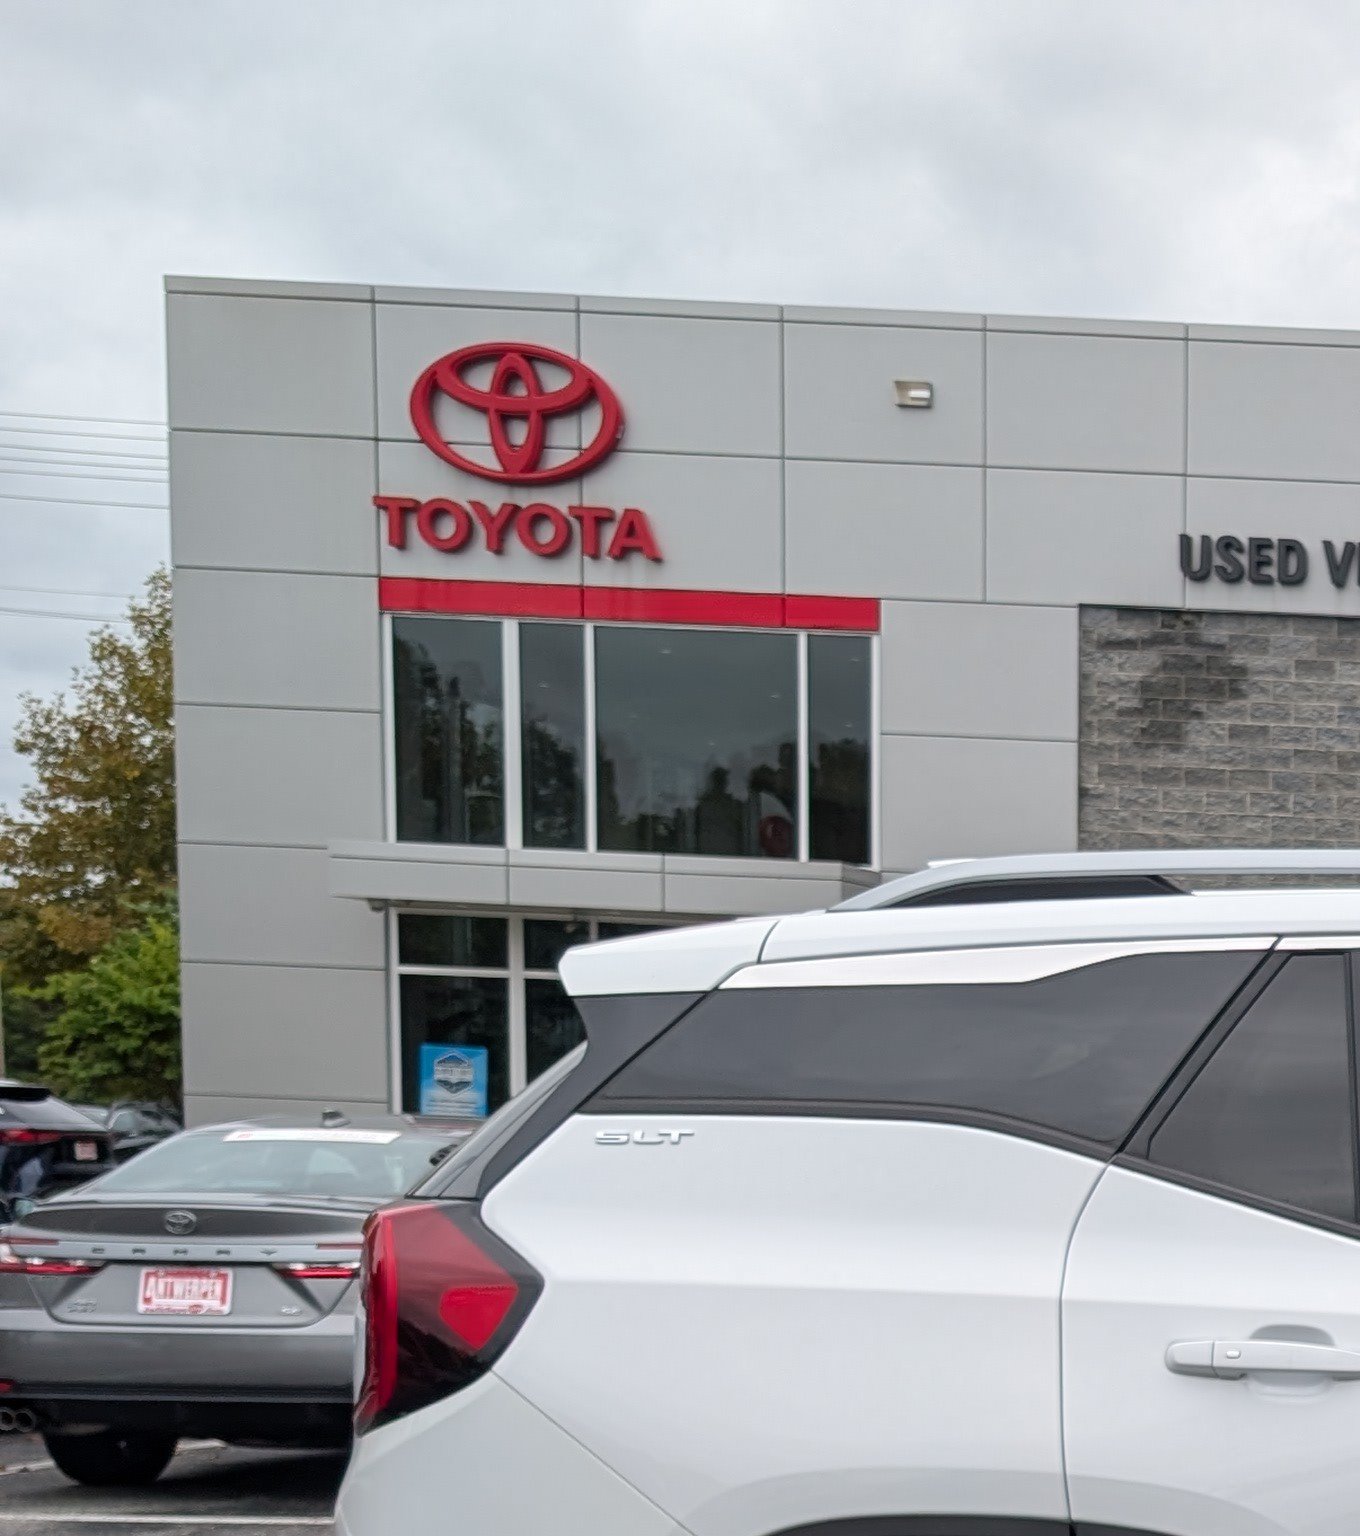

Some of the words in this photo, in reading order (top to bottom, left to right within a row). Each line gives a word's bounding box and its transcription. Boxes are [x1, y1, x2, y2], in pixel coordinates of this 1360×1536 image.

[372, 495, 664, 563] TOYOTA
[1179, 533, 1309, 586] USED
[594, 1128, 695, 1145] SLT
